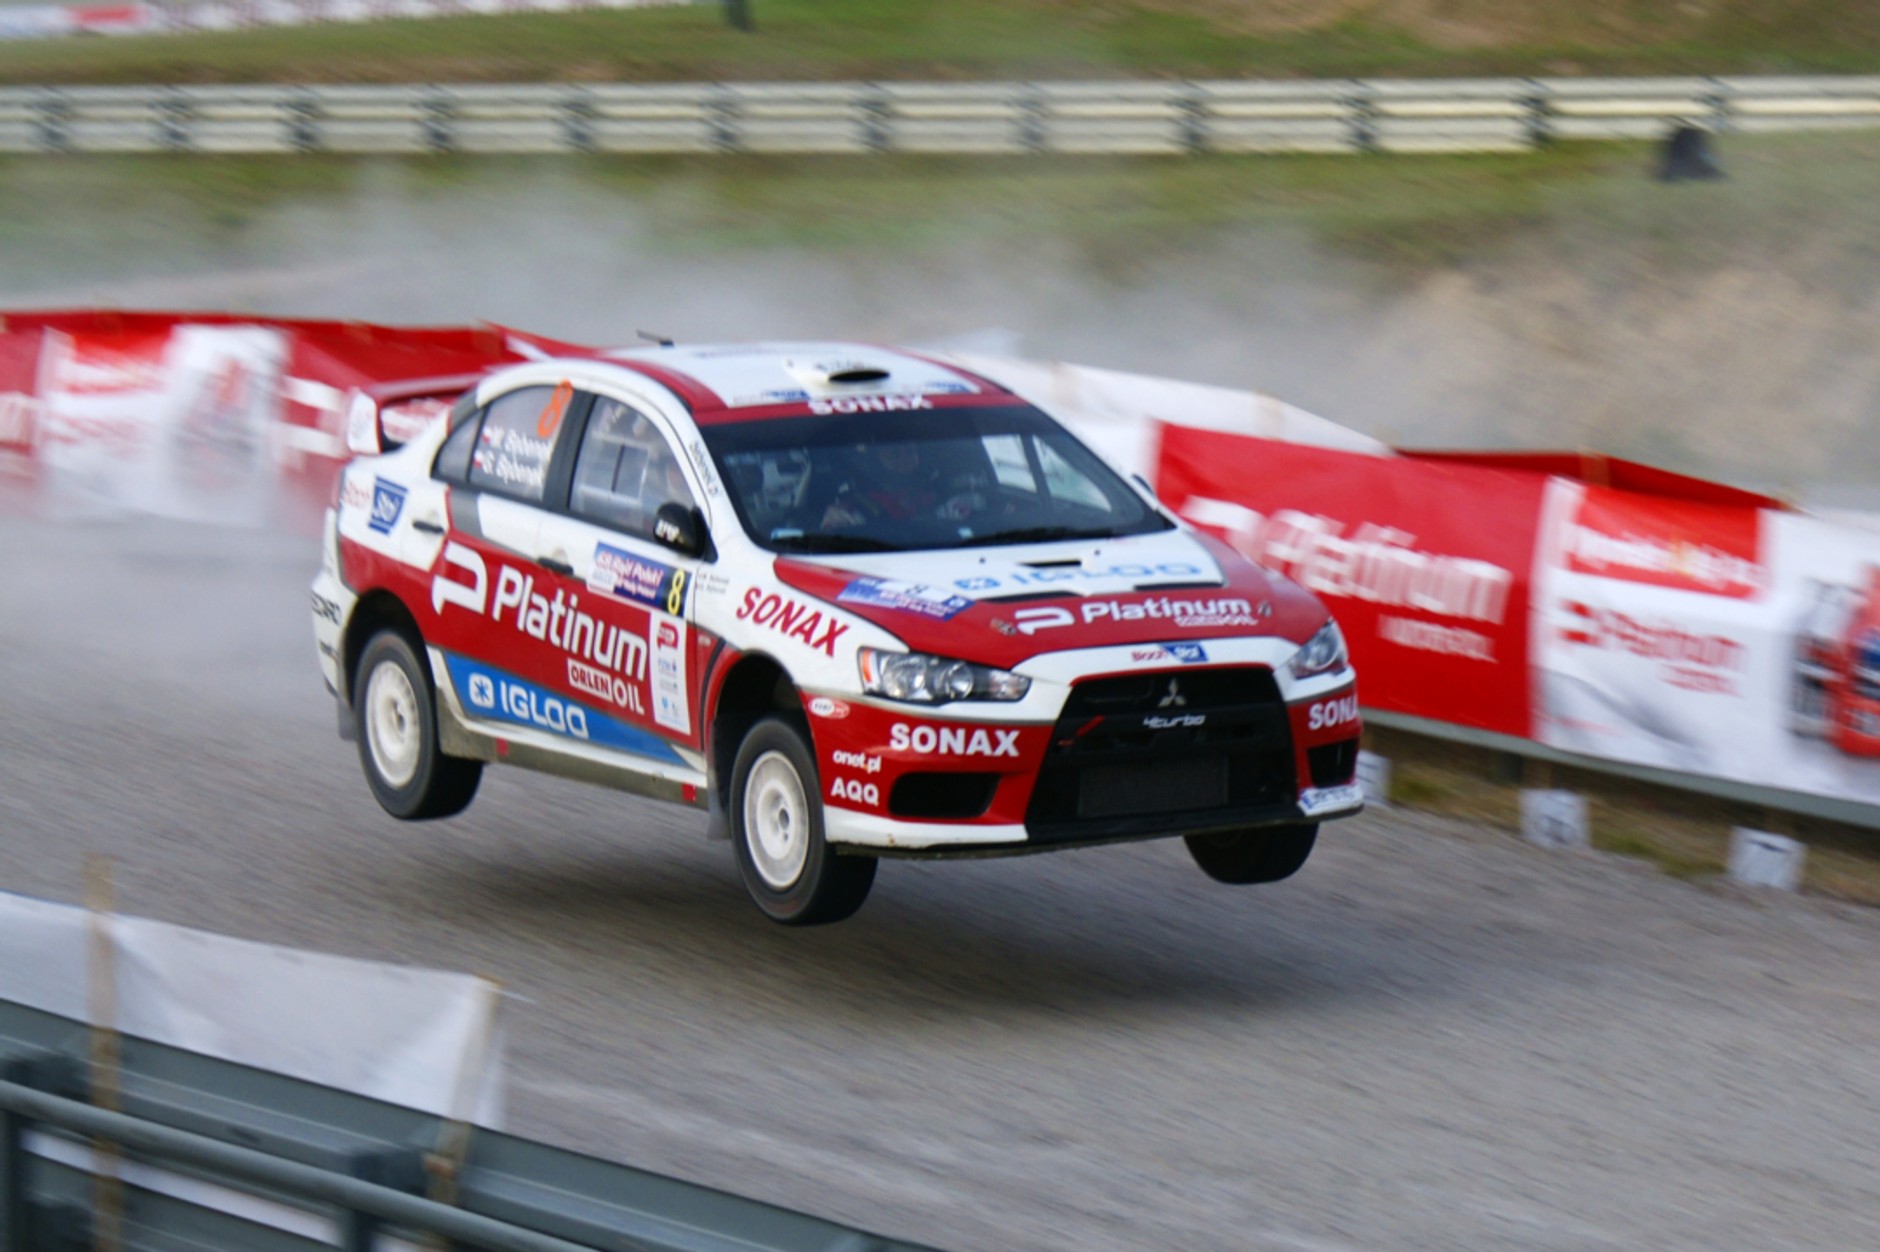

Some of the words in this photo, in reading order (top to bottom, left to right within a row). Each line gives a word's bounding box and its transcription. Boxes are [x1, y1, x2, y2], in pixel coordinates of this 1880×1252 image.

[536, 379, 574, 439] 8
[667, 568, 685, 616] 8
[1081, 597, 1251, 624] Platinum
[492, 564, 648, 682] Platinum
[736, 587, 850, 658] SONAX
[500, 680, 589, 740] IGLOO
[570, 665, 609, 697] ORLEN
[613, 677, 645, 716] OIL
[832, 749, 882, 775] onet.pl
[889, 722, 1021, 757] SONAX
[830, 776, 880, 807] AQQ
